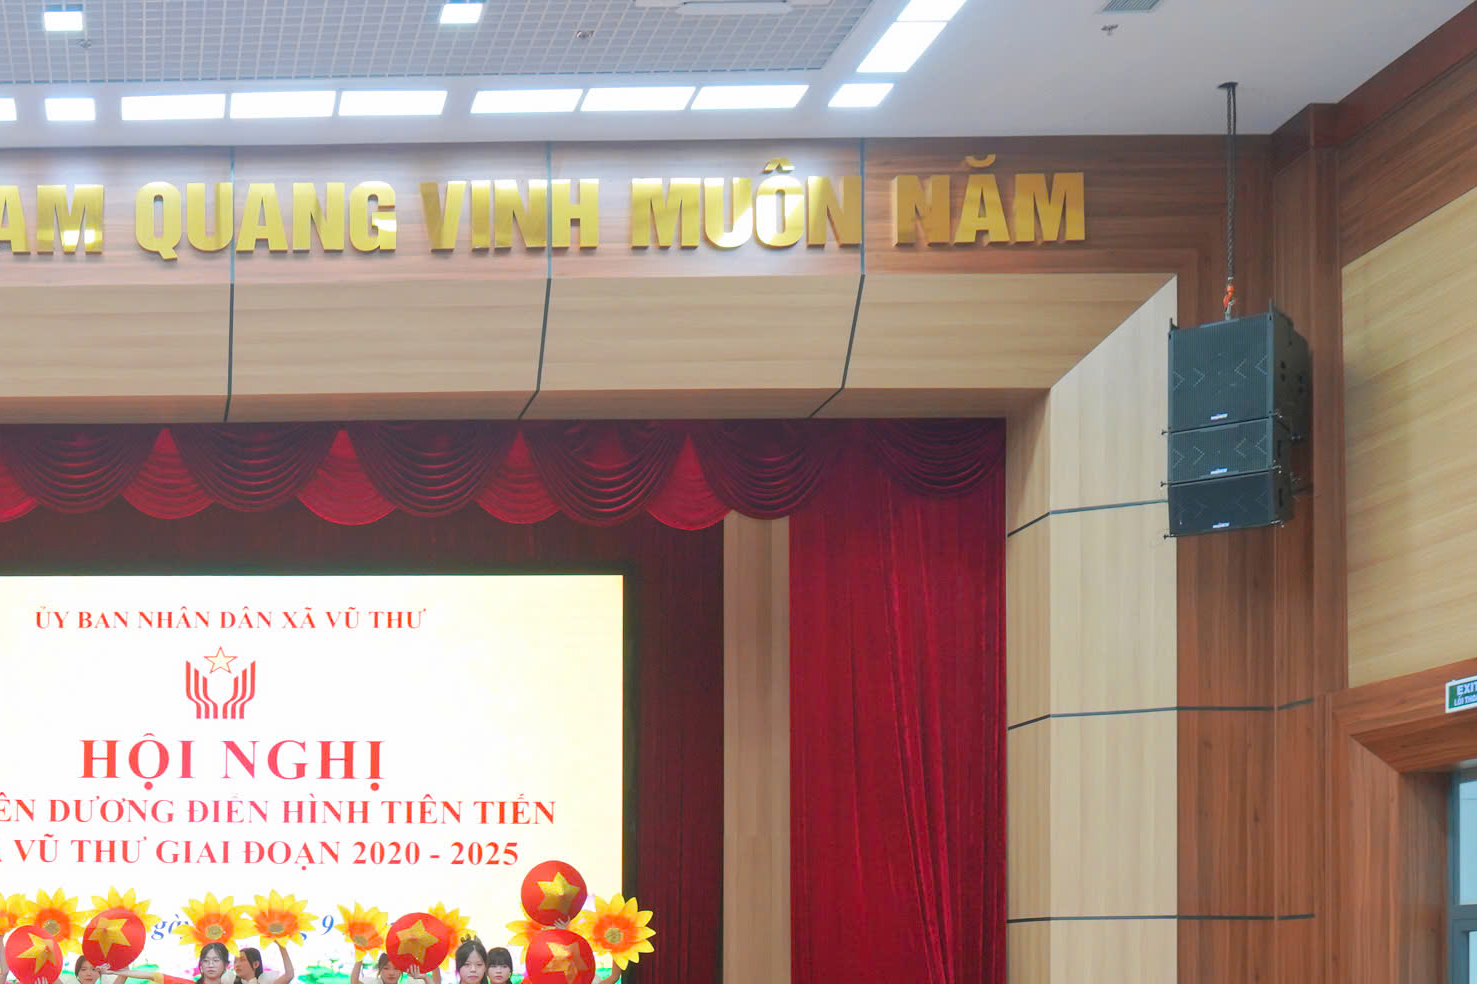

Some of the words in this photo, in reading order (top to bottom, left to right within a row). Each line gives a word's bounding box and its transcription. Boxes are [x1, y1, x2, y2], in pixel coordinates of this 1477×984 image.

[135, 179, 397, 260] QUANG
[419, 177, 599, 252] VINH
[631, 157, 862, 250] MUÔN
[892, 153, 1087, 247] NĂM
[35, 604, 69, 629] ỦY
[77, 611, 129, 629] BAN
[138, 605, 210, 629] NHÂN
[219, 605, 272, 629] DÂN
[281, 606, 316, 629] XÃ
[325, 606, 360, 629] VŨ
[367, 607, 427, 629] THƯ
[1456, 680, 1477, 696] EXI
[78, 733, 196, 790] HỘI
[220, 740, 385, 792] NGHỊ
[49, 795, 175, 824] DƯƠNG
[282, 792, 370, 824] HÌNH
[380, 793, 463, 824] TIÊN
[473, 793, 556, 824] TIẾN
[14, 833, 59, 863] VŨ
[71, 836, 148, 863] THƯ
[156, 840, 230, 864] GIAI
[243, 840, 341, 871] ĐOẠN
[352, 841, 421, 864] 2020
[450, 841, 519, 865] 2025
